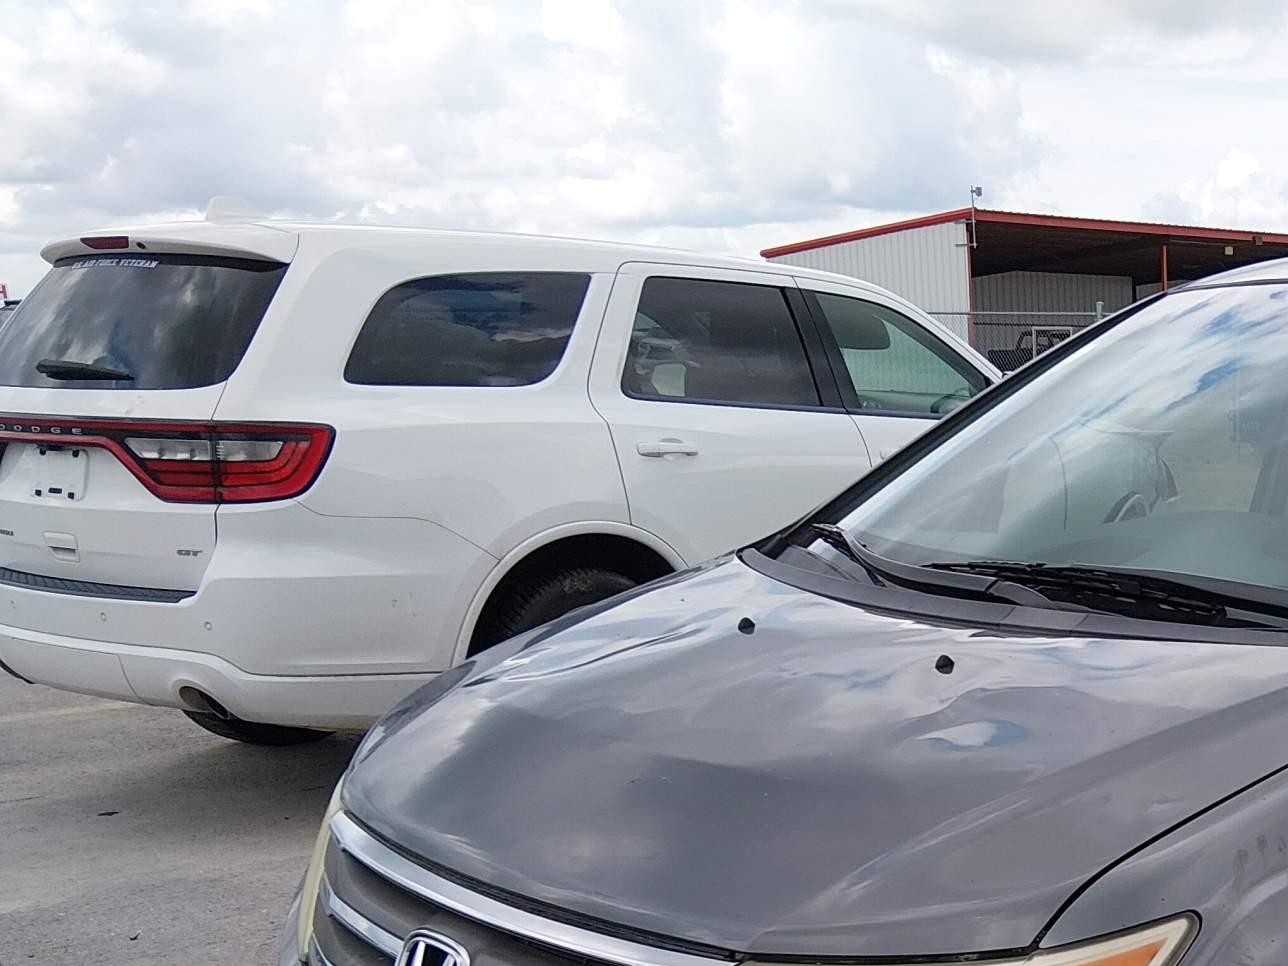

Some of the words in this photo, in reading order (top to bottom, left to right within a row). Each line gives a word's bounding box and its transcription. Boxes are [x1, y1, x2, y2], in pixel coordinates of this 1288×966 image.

[96, 258, 119, 266] FORCE
[119, 258, 160, 268] VETERAN
[176, 549, 203, 557] GT
